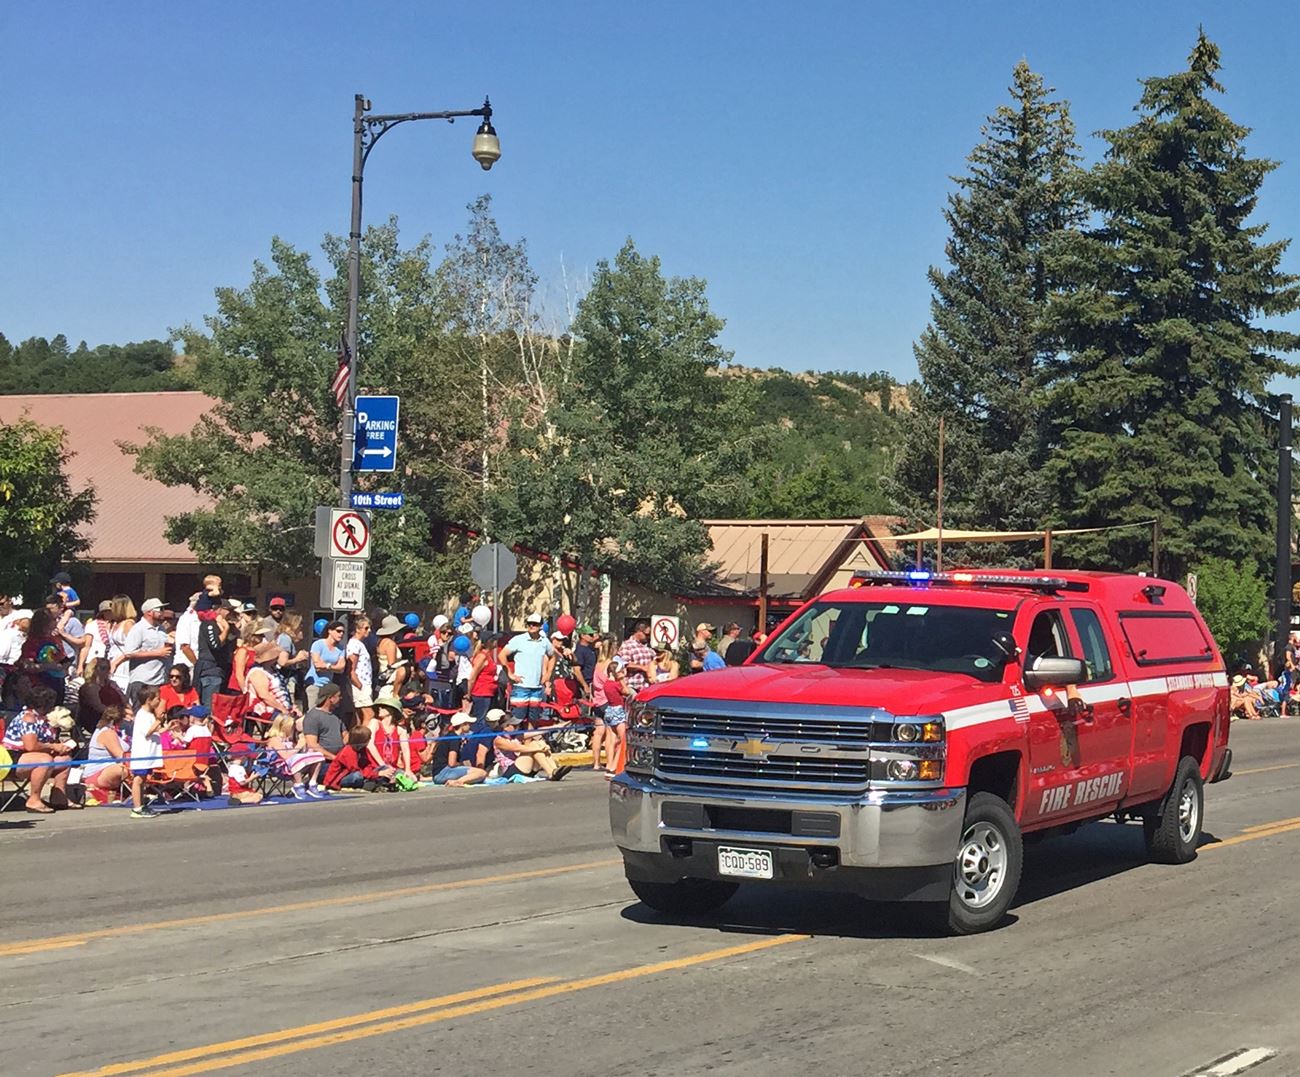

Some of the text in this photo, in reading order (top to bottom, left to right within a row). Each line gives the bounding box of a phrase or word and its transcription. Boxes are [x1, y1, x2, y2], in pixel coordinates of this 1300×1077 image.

[358, 412, 396, 431] PARKING
[366, 431, 385, 440] FREE
[353, 494, 402, 505] 10th Street
[1038, 771, 1124, 815] FIRE RESCUE
